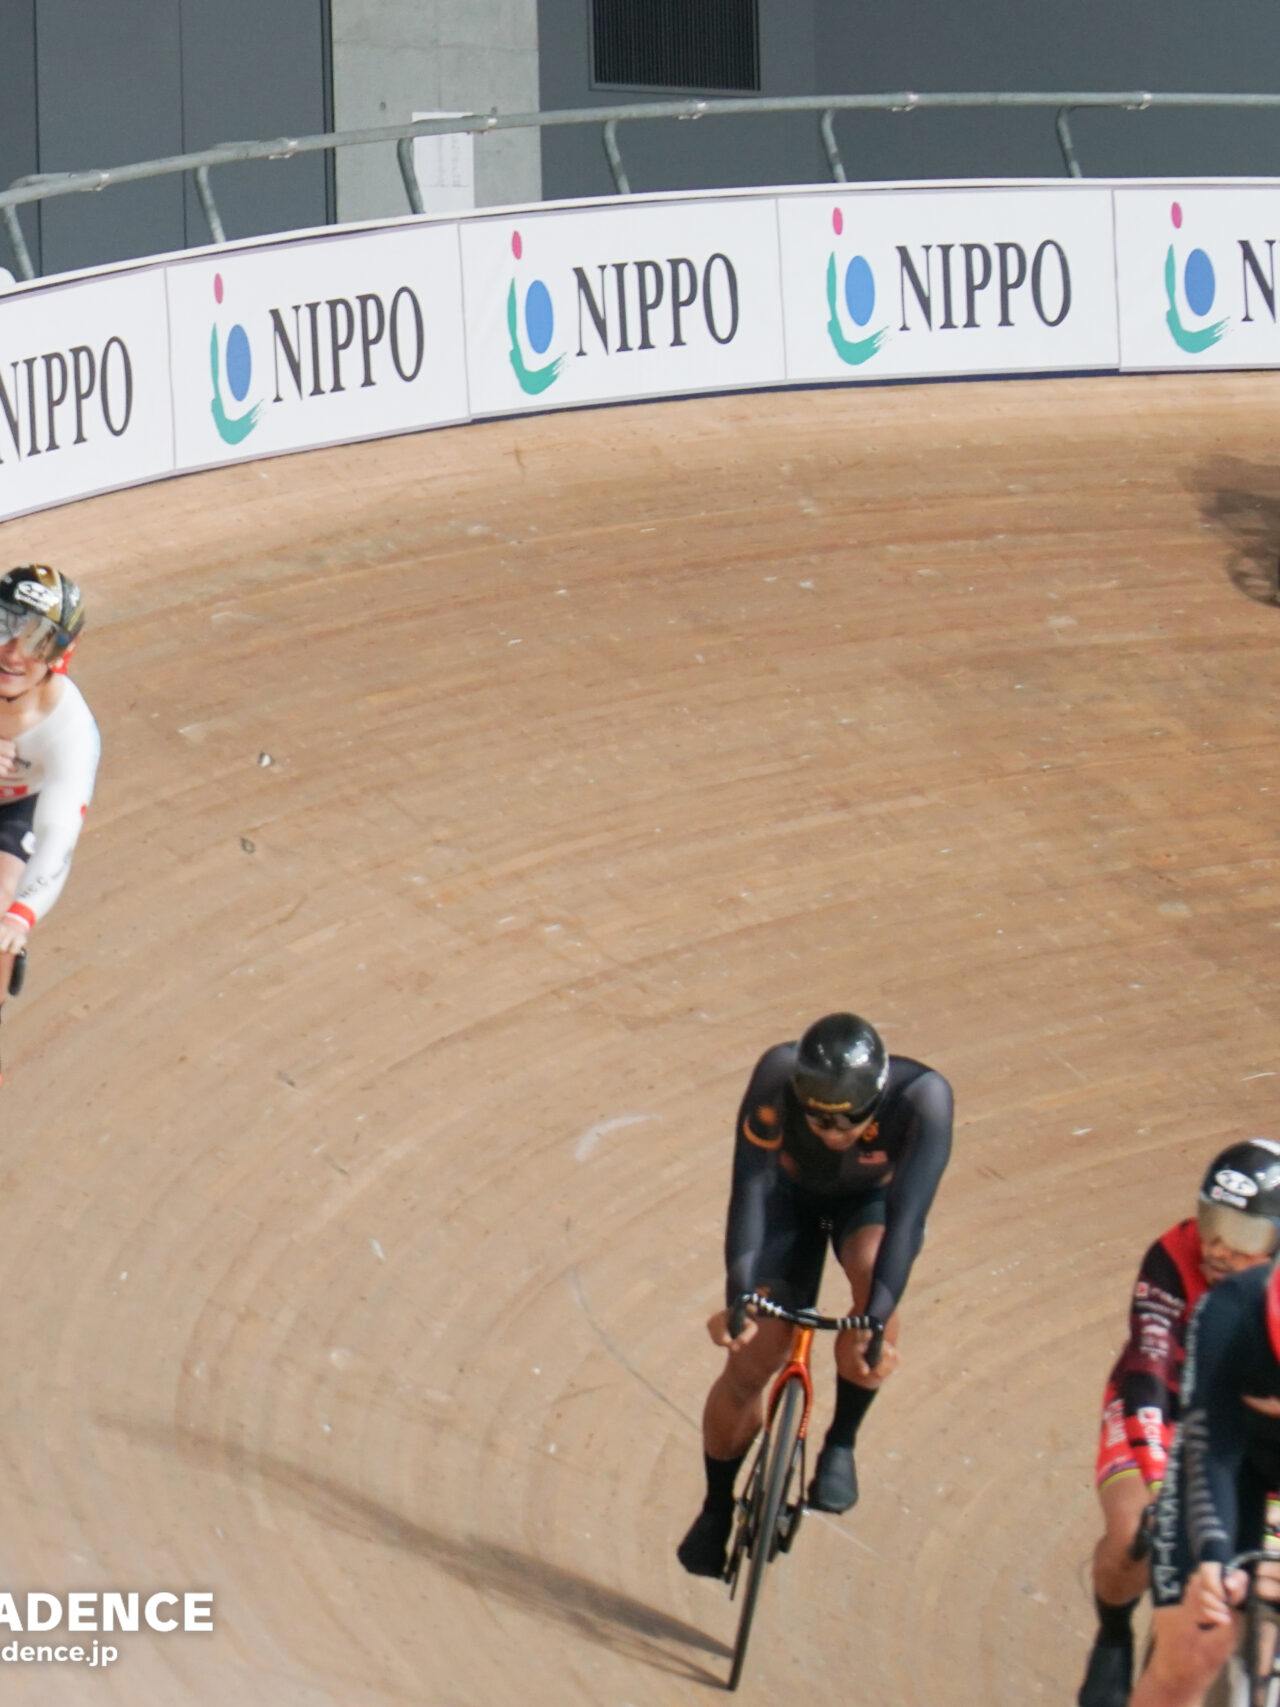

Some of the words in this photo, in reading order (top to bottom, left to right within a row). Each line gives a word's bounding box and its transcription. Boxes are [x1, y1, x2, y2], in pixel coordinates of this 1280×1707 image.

[572, 252, 740, 357] NIPPO
[895, 239, 1071, 332] NIPPO
[269, 286, 425, 404] NIPPO
